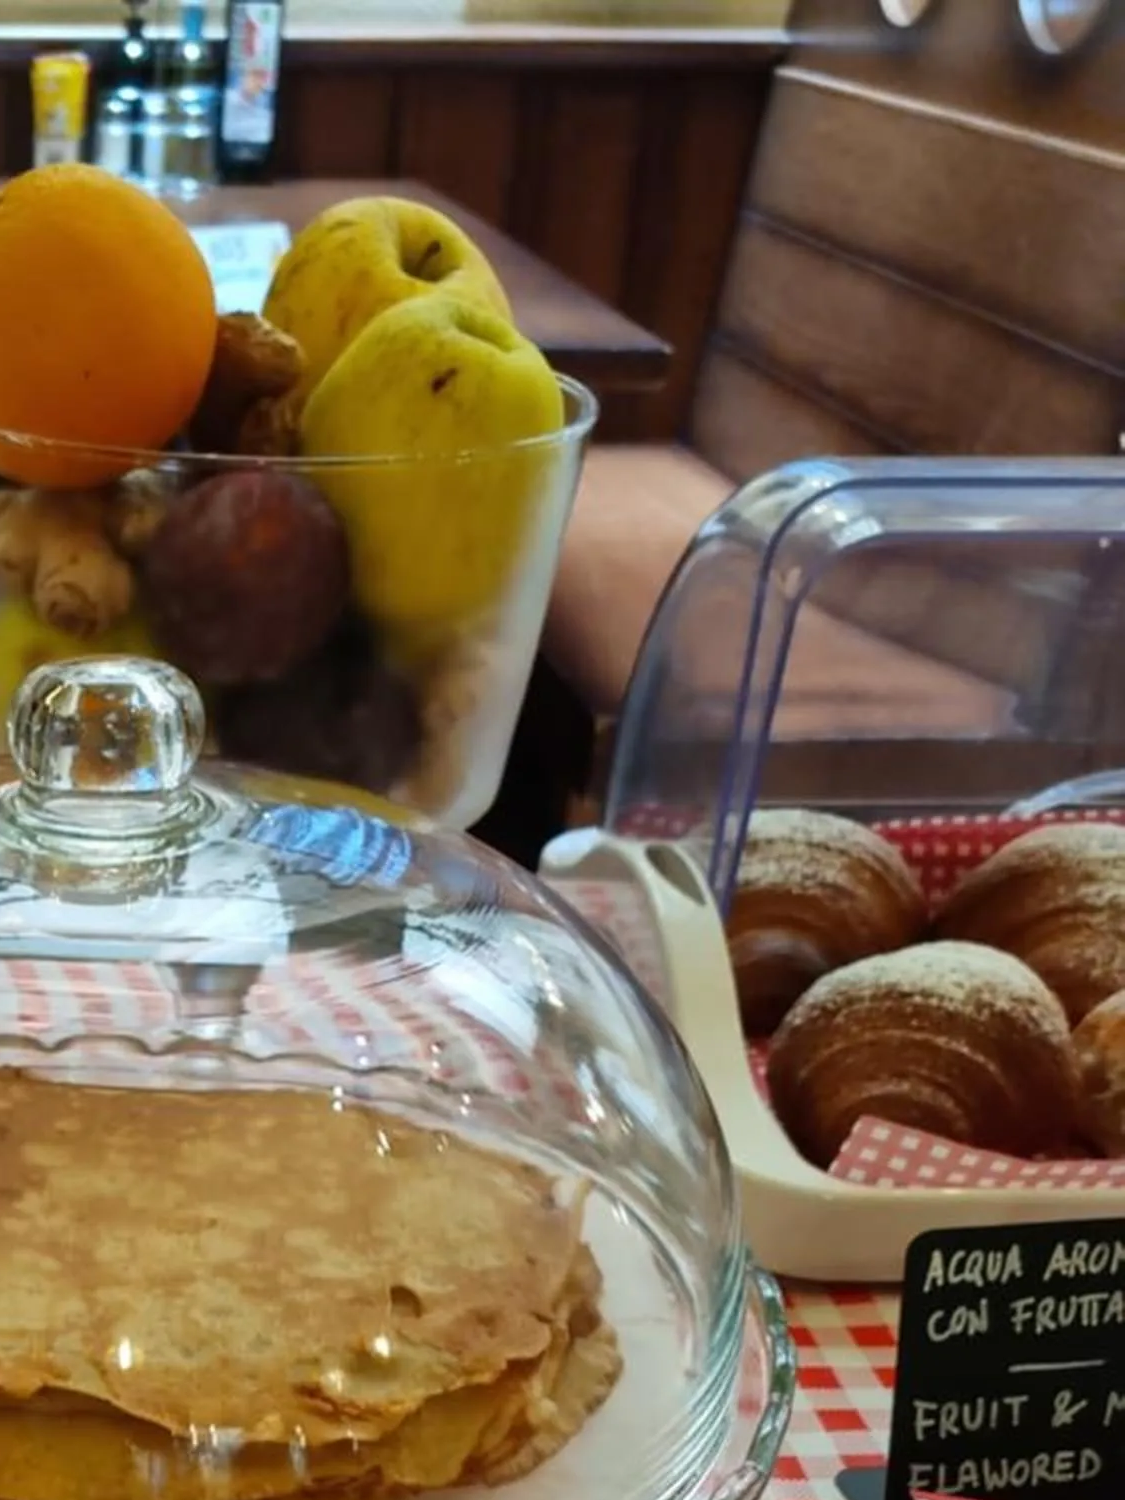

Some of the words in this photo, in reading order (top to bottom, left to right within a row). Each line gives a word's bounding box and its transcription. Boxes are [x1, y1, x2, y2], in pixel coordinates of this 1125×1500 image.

[923, 1244, 1023, 1292] ACQUA
[927, 1298, 989, 1342] CON
[1010, 1290, 1125, 1335] FRUTTA
[912, 1395, 1029, 1441] FRUIT
[1051, 1390, 1087, 1427] &
